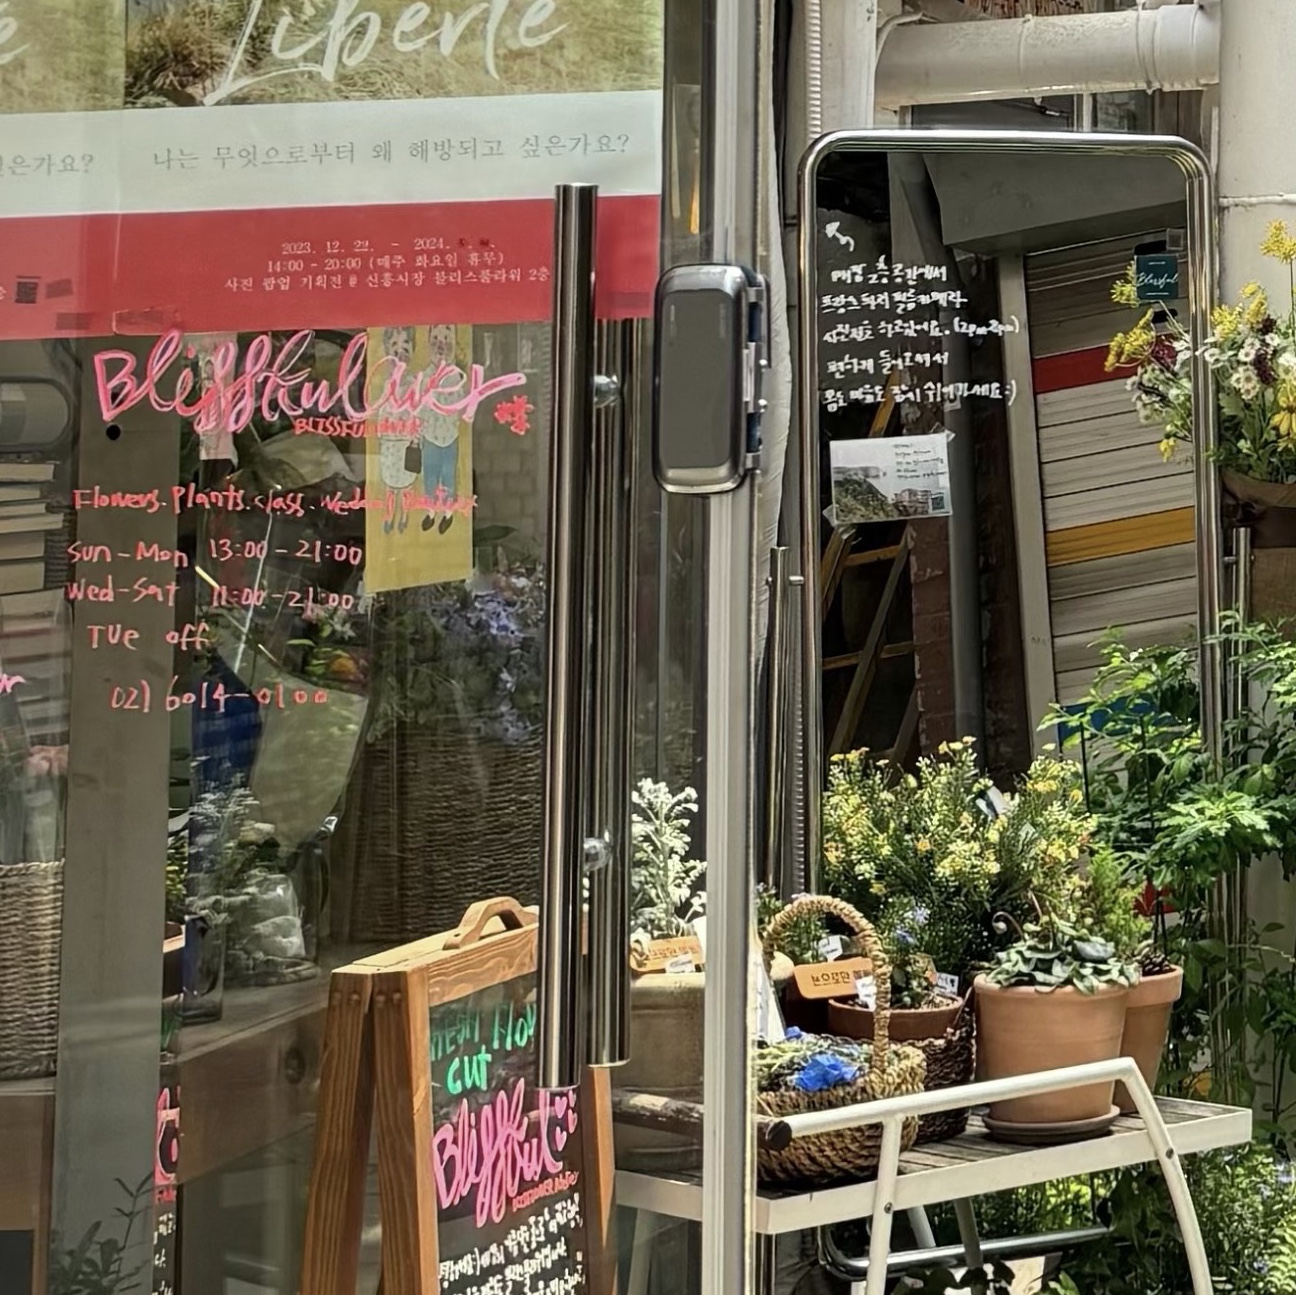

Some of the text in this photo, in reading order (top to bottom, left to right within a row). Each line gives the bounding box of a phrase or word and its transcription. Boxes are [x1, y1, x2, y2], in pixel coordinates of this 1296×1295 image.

[0, 151, 95, 178] 은가요?
[153, 130, 632, 172] 나는 무엇으로부터 왜 해방되고 싶은가요?
[281, 241, 317, 255] 2023.
[326, 240, 345, 253] 12.
[414, 237, 450, 251] 2024.
[267, 259, 304, 274] 14:00
[324, 257, 362, 272] 20:00
[415, 253, 458, 269] 화요일
[468, 251, 505, 268] 휴무)
[224, 276, 254, 293] 사진
[262, 276, 291, 292] 팝업
[300, 274, 343, 291] 기획전
[367, 272, 426, 289] 신흥시장
[434, 268, 522, 286] 블리스풀라워
[528, 266, 551, 283] 2층
